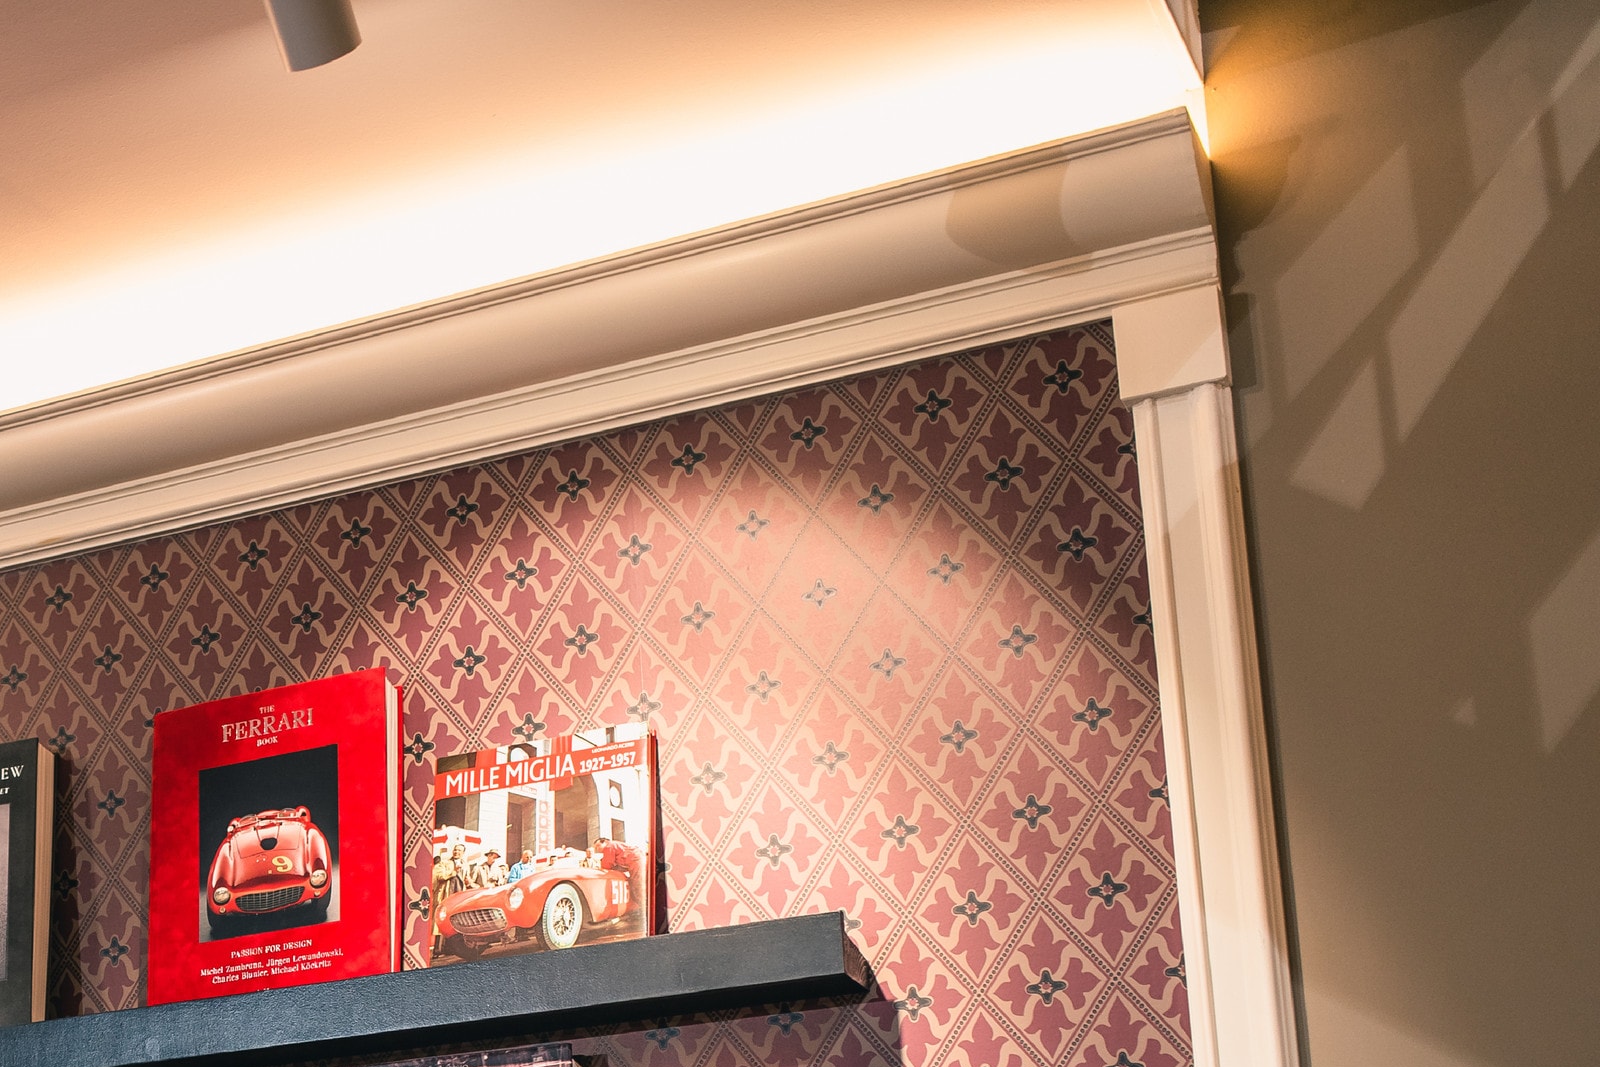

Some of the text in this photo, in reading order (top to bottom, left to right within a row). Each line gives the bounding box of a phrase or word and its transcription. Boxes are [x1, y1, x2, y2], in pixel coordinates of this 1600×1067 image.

[259, 704, 275, 714] THE
[221, 708, 314, 743] FERRARI
[256, 735, 278, 747] BOOK
[445, 766, 499, 796] MILLE
[505, 753, 575, 786] MIGLIA
[271, 855, 293, 873] 9
[231, 939, 312, 959] PASSION FOR DESIGN
[200, 966, 224, 977] Michel
[211, 973, 239, 984] Charles
[271, 963, 299, 975] Michael
